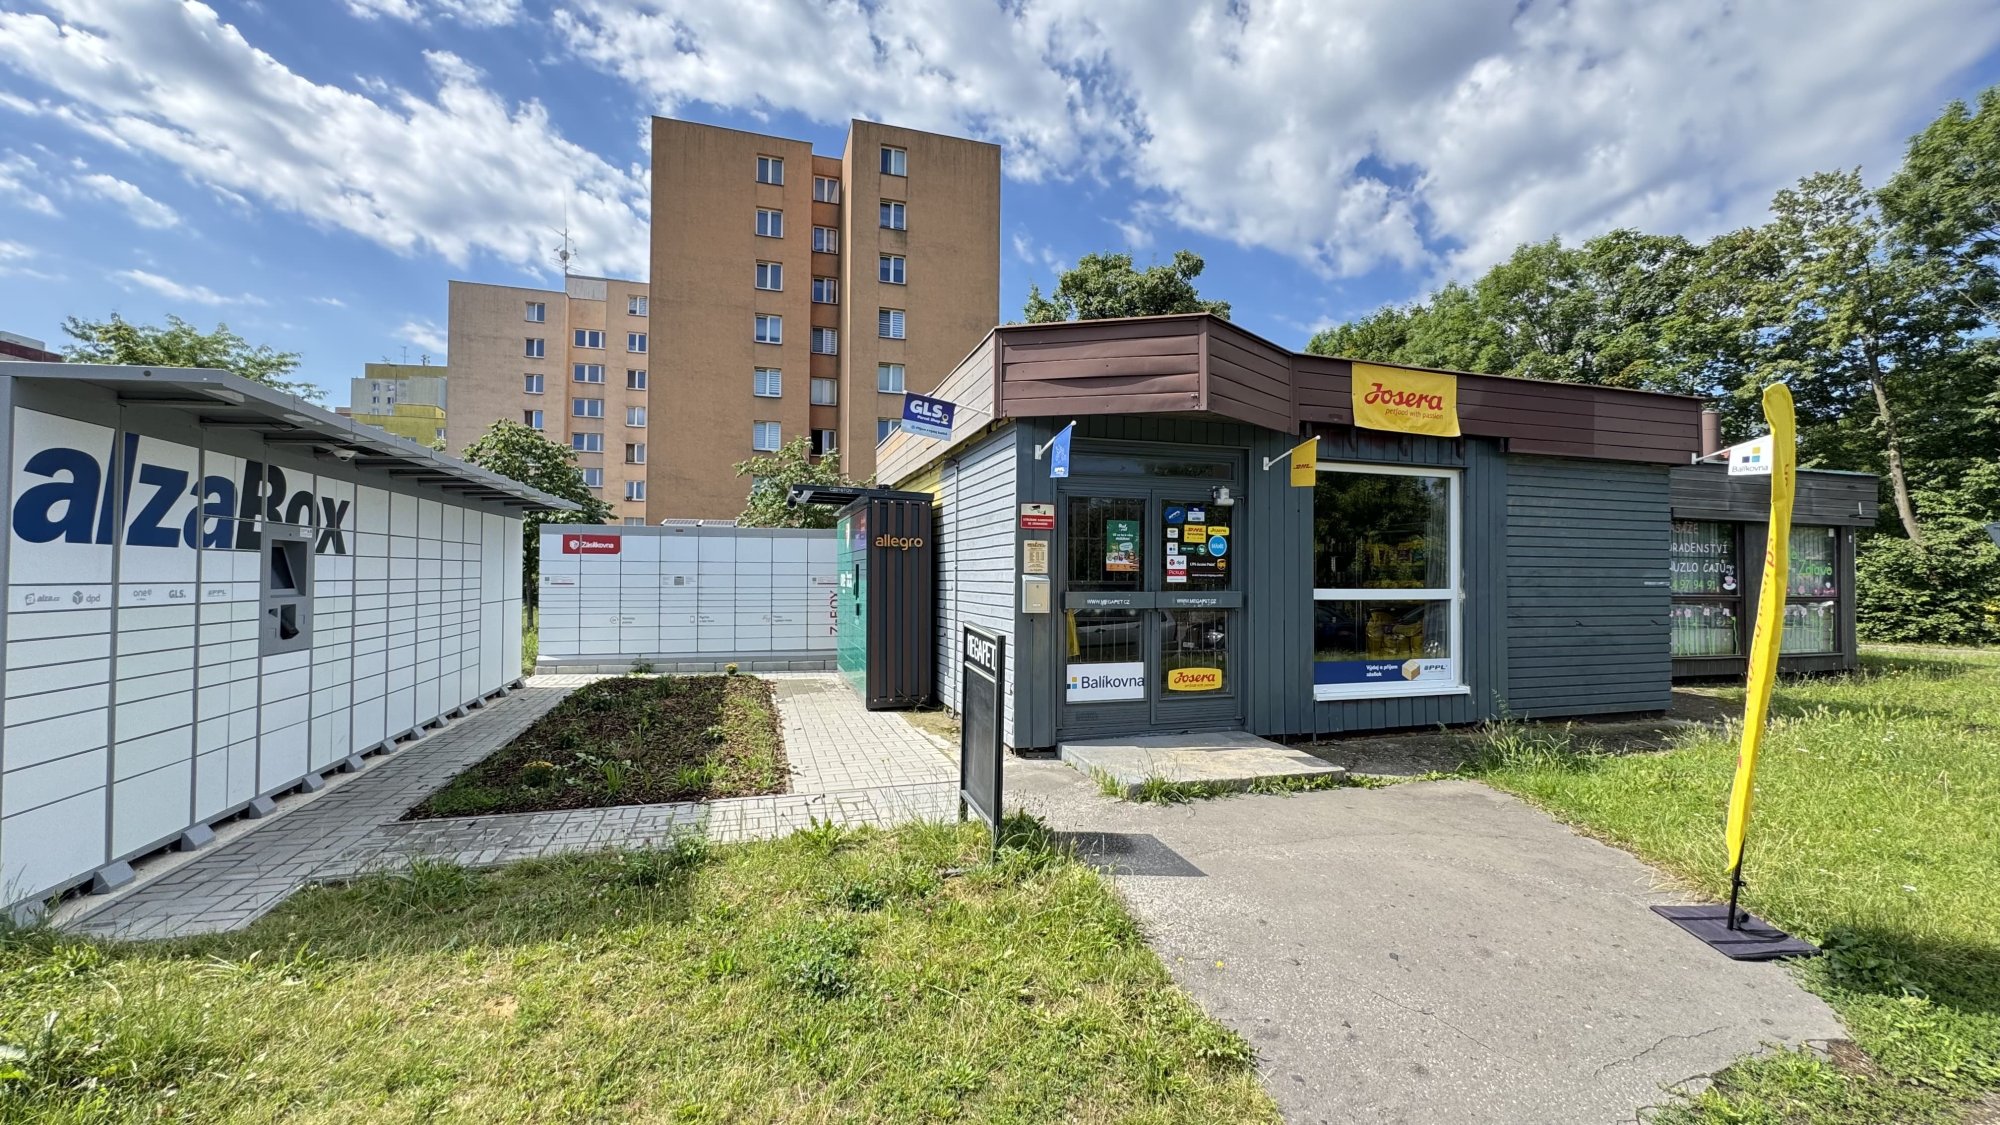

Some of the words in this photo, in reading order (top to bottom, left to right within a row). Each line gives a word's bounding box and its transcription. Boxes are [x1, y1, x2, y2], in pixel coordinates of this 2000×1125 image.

[1364, 382, 1443, 411] Josera
[910, 399, 943, 418] GLS
[1385, 407, 1408, 416] petfood
[1422, 412, 1444, 420] passion
[1731, 465, 1769, 473] Balíkovna
[13, 432, 350, 555] alzaBox
[875, 533, 924, 551] allegro
[86, 593, 101, 603] dpd
[1081, 675, 1145, 689] Balíkovna
[1174, 671, 1216, 684] Josera
